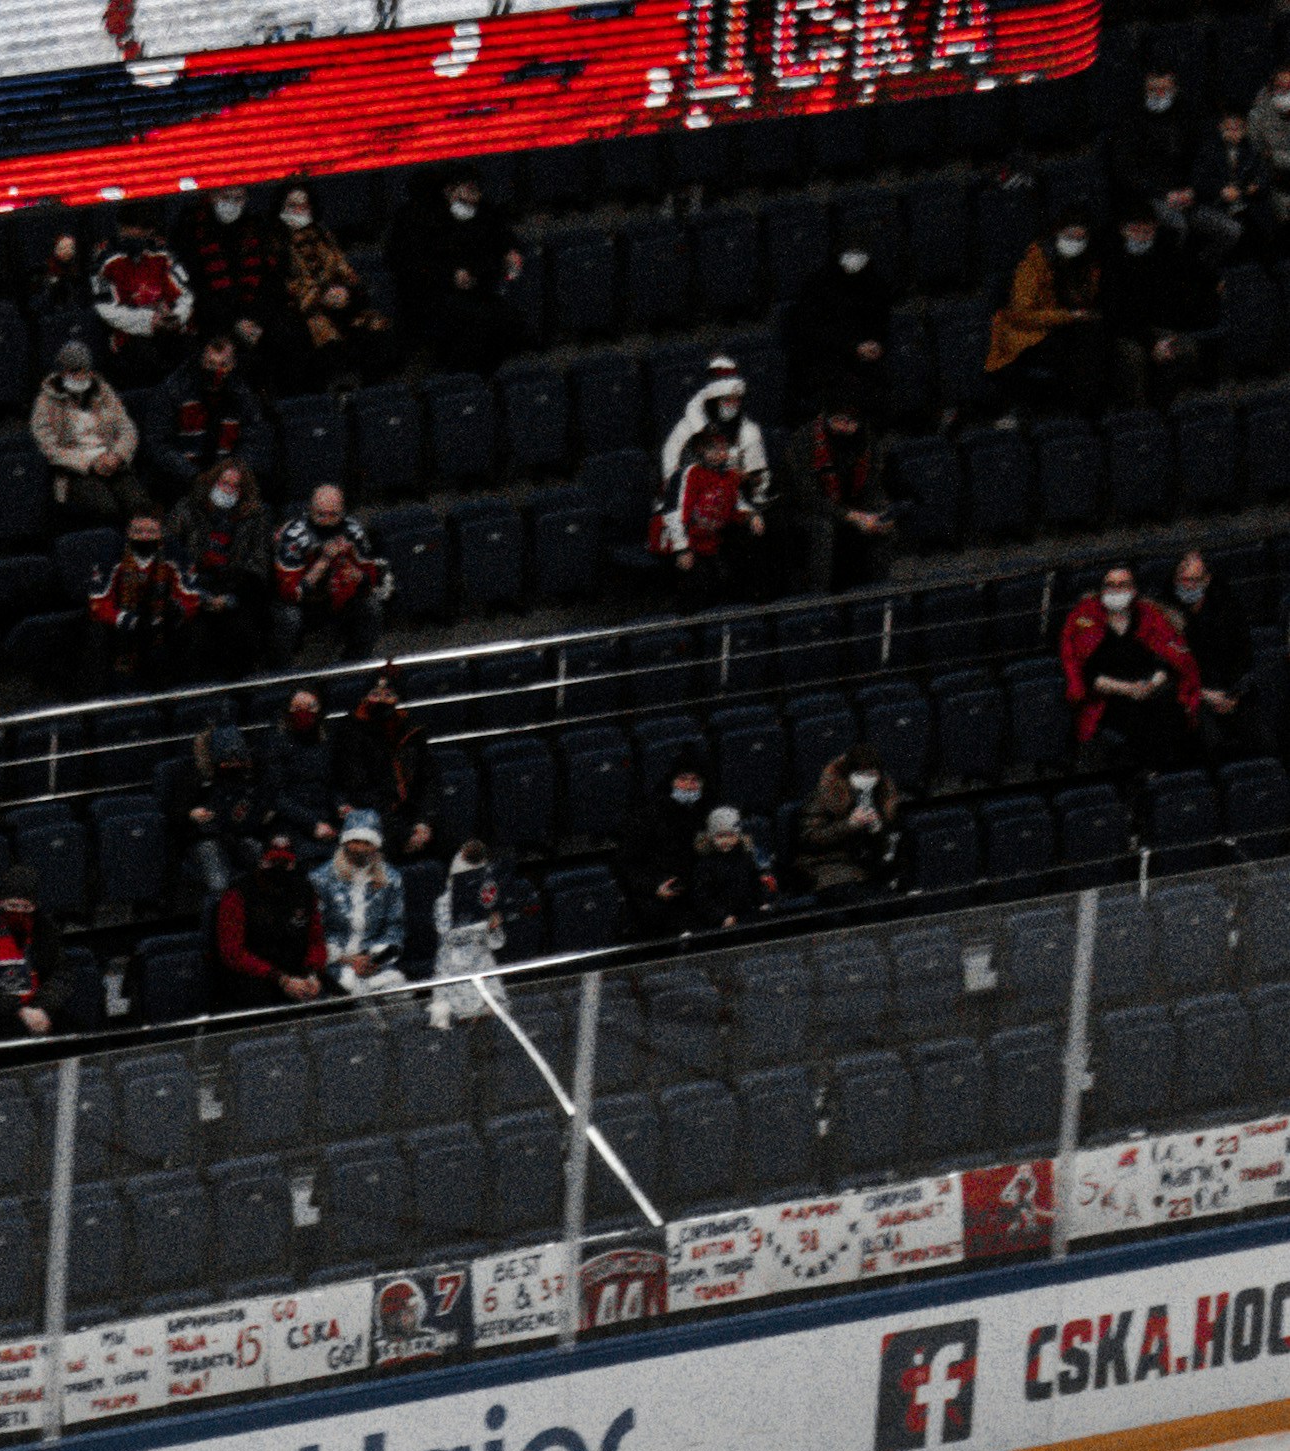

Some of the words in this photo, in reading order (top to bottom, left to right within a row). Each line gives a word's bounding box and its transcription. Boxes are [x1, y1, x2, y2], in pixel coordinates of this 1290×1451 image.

[493, 1254, 544, 1283] BEST
[435, 1270, 468, 1317] 7
[271, 1299, 298, 1323] GO
[287, 1318, 342, 1350] CSKA
